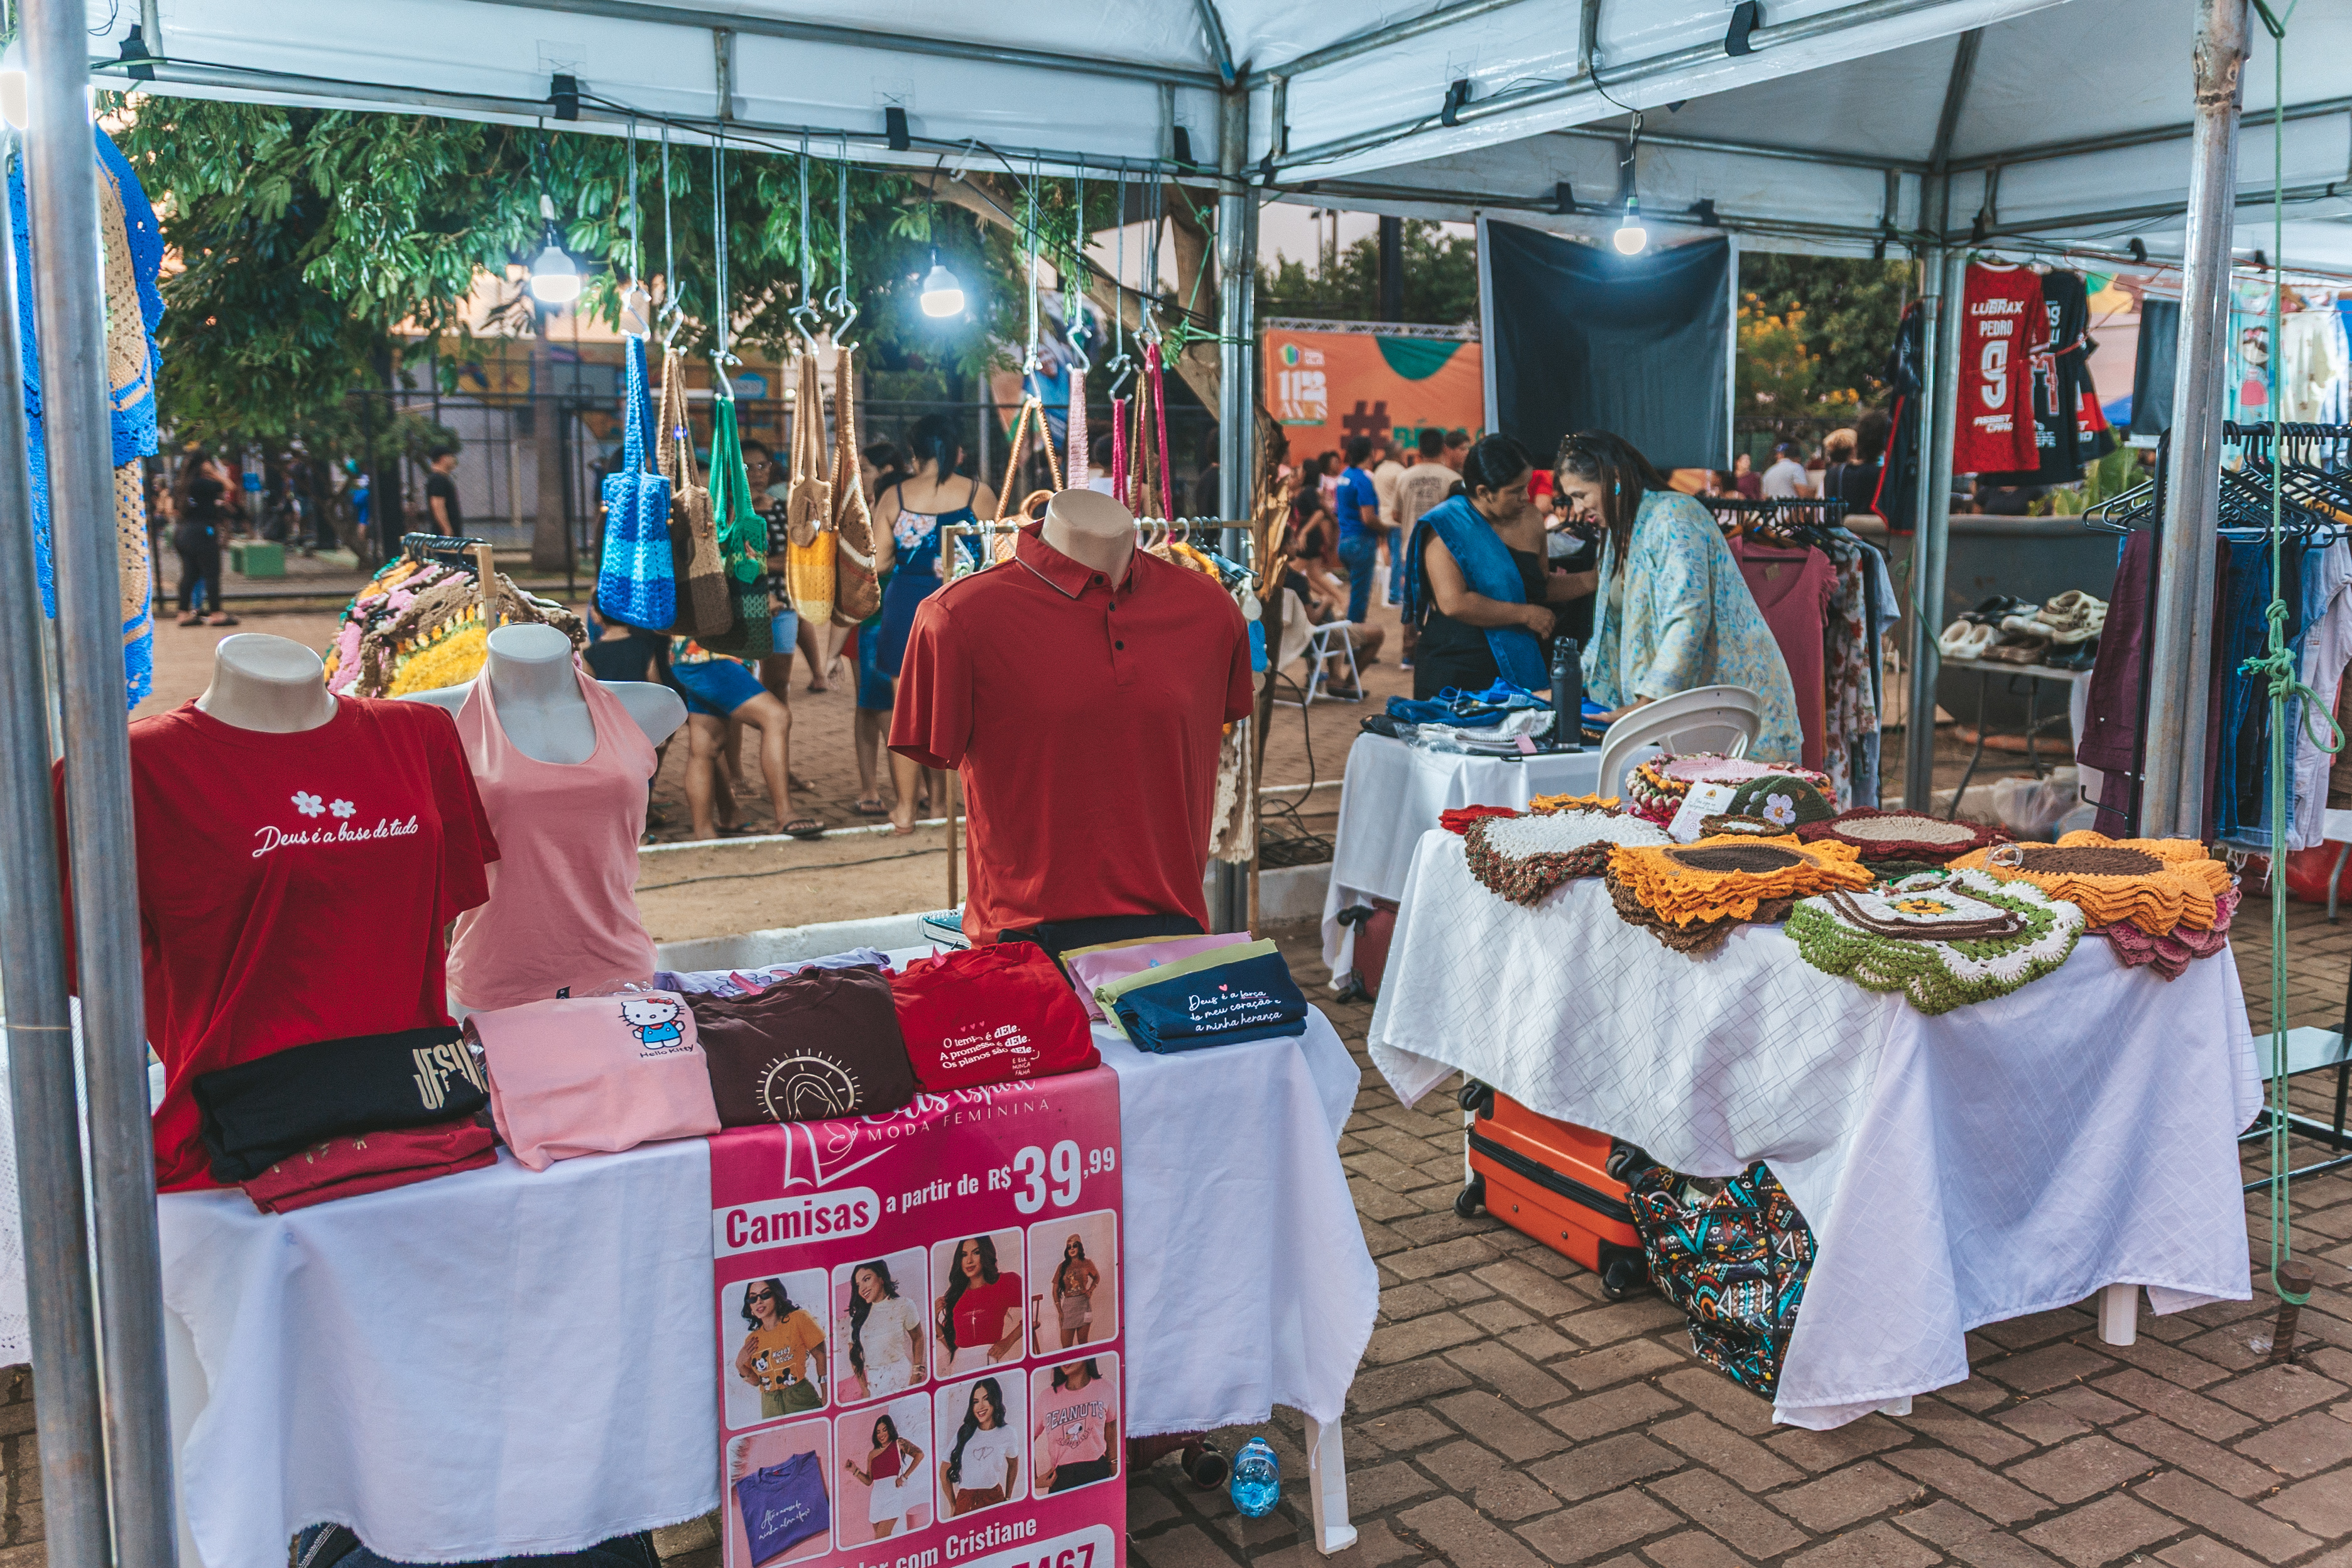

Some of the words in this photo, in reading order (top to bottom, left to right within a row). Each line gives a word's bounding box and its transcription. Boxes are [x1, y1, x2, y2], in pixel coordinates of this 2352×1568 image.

[1971, 298, 2025, 315] LUBRAX
[1979, 319, 2013, 337] PEDRO
[1981, 340, 2009, 410] 9
[253, 826, 310, 857] Deus
[312, 827, 321, 842] é
[323, 831, 336, 842] a
[338, 821, 371, 841] base
[373, 818, 389, 837] de
[389, 815, 418, 836] tudo
[1189, 995, 1218, 1011] Deus
[1240, 990, 1266, 998] força
[1205, 1007, 1228, 1018] meu
[1230, 998, 1272, 1010] coração
[1206, 1018, 1239, 1031] minha
[1241, 1013, 1282, 1025] herança
[940, 1052, 949, 1061] A
[950, 1042, 996, 1060] promessa
[1004, 1035, 1031, 1047] dEle.
[944, 1038, 952, 1048] O
[985, 1032, 992, 1040] é
[994, 1025, 1021, 1038] dEle.
[668, 1044, 694, 1054] Kitty
[958, 1052, 991, 1067] planos
[991, 1047, 1009, 1055] são
[868, 1120, 930, 1141] MODA
[944, 1099, 1049, 1127] FEMININA
[727, 1200, 870, 1249] Camisas
[886, 1195, 896, 1213] a
[902, 1179, 952, 1214] partir
[957, 1173, 979, 1196] de
[988, 1164, 1012, 1190] R$
[1045, 1400, 1104, 1431] PEANUTS
[896, 1547, 939, 1568] com
[945, 1518, 1037, 1560] Cristiane
